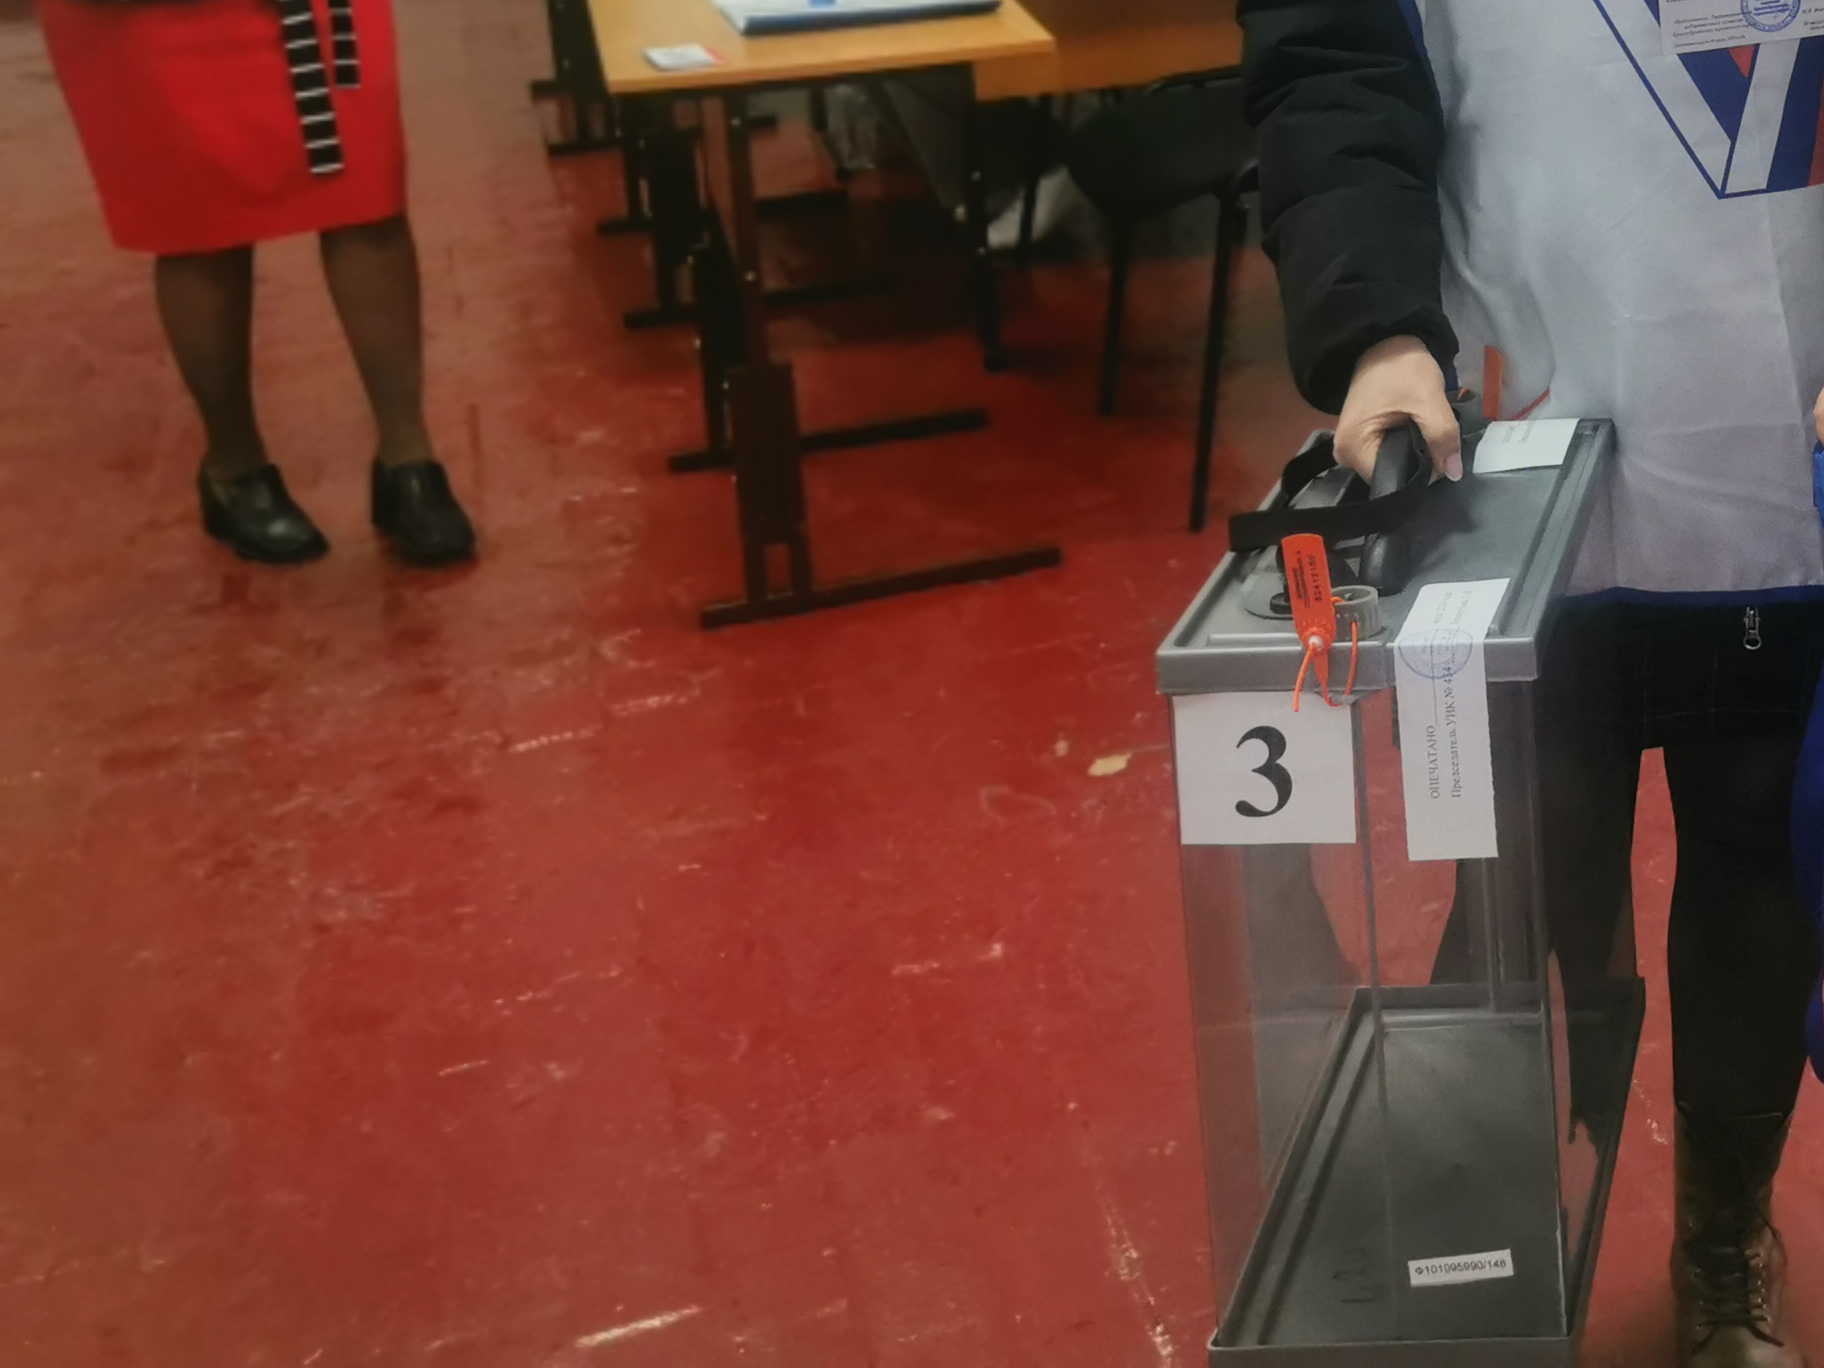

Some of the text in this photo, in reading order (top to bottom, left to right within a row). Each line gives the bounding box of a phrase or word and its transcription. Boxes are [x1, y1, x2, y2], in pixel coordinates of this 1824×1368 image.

[1235, 725, 1293, 818] 3
[1425, 725, 1440, 799] ОПЕЧАТАНО
[1449, 728, 1463, 798] Председатель
